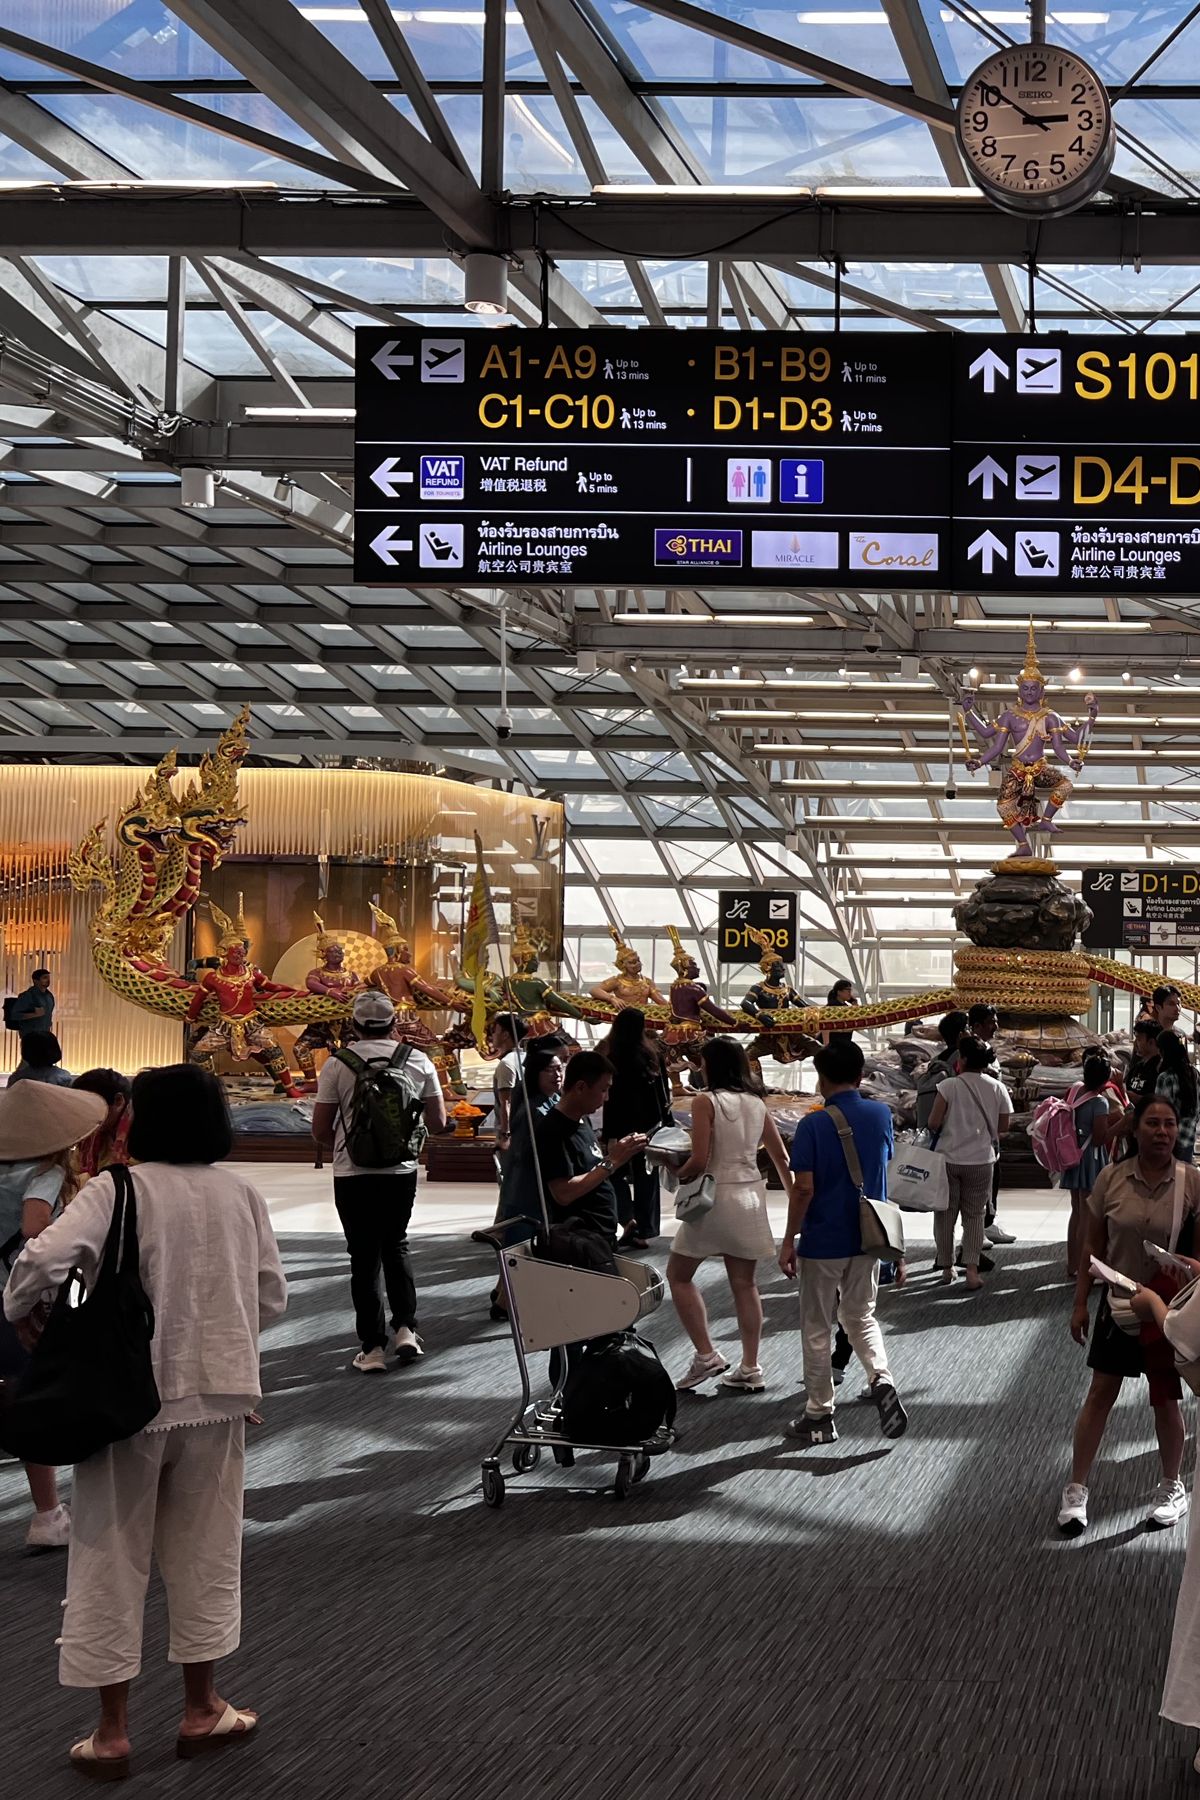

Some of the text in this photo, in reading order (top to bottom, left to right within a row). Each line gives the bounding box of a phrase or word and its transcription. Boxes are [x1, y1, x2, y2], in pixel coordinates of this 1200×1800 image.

[1002, 66, 1018, 87] 11
[1025, 60, 1047, 82] 12
[1018, 91, 1053, 99] SEIKO
[1071, 84, 1086, 104] 2
[973, 111, 988, 132] 9
[1078, 110, 1093, 131] 3
[981, 136, 997, 157] 8
[1069, 136, 1085, 156] 4
[1001, 154, 1017, 175] 7
[1023, 160, 1039, 180] 6
[1050, 154, 1065, 175] 5
[479, 344, 597, 380] A1-A9
[616, 359, 639, 370] Up to
[714, 346, 832, 382] B1-B9
[855, 362, 877, 373] Up to
[616, 371, 649, 380] 13 mins
[855, 374, 887, 383] 11 mins
[478, 393, 615, 430] C1-C10
[632, 408, 656, 419] Up to
[713, 395, 833, 431] D1-D3
[853, 411, 877, 422] Up to
[633, 420, 667, 430] 13 mins
[853, 423, 883, 432] 7 mins
[425, 460, 460, 477] VAT
[480, 457, 568, 471] VAT Refund
[425, 478, 460, 486] REFUND
[479, 478, 547, 492] 增值税退税
[589, 472, 613, 483] Up to
[589, 484, 618, 493] 5 mins
[477, 520, 619, 539] ห้องรับรองสายการบิน
[477, 542, 588, 558] Airline Lounges
[688, 538, 731, 553] THAI
[775, 554, 815, 563] MIRACLE
[861, 541, 934, 567] Coral
[1070, 547, 1181, 564] Airline Lounges
[477, 560, 573, 574] 航空公司贵宾室
[1070, 565, 1166, 579] 航空公司贵宾室
[1166, 905, 1192, 913] Lounges
[725, 928, 789, 948] D1D8
